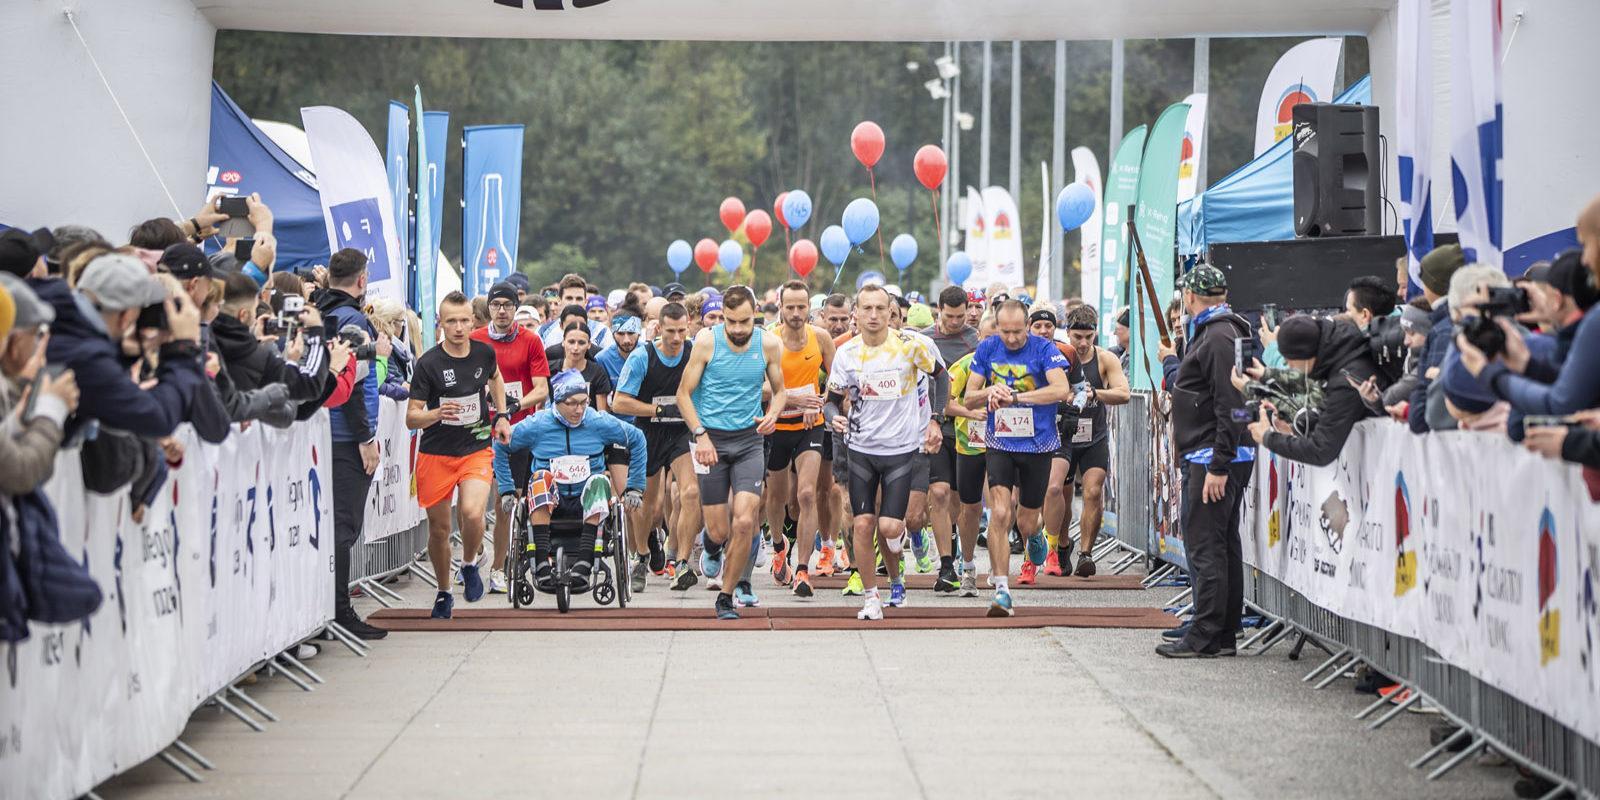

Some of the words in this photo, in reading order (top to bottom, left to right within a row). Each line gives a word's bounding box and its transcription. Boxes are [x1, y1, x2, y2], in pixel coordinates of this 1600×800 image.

[878, 379, 897, 389] 400
[460, 402, 478, 414] 578
[1012, 416, 1029, 427] 174
[568, 464, 587, 473] 646
